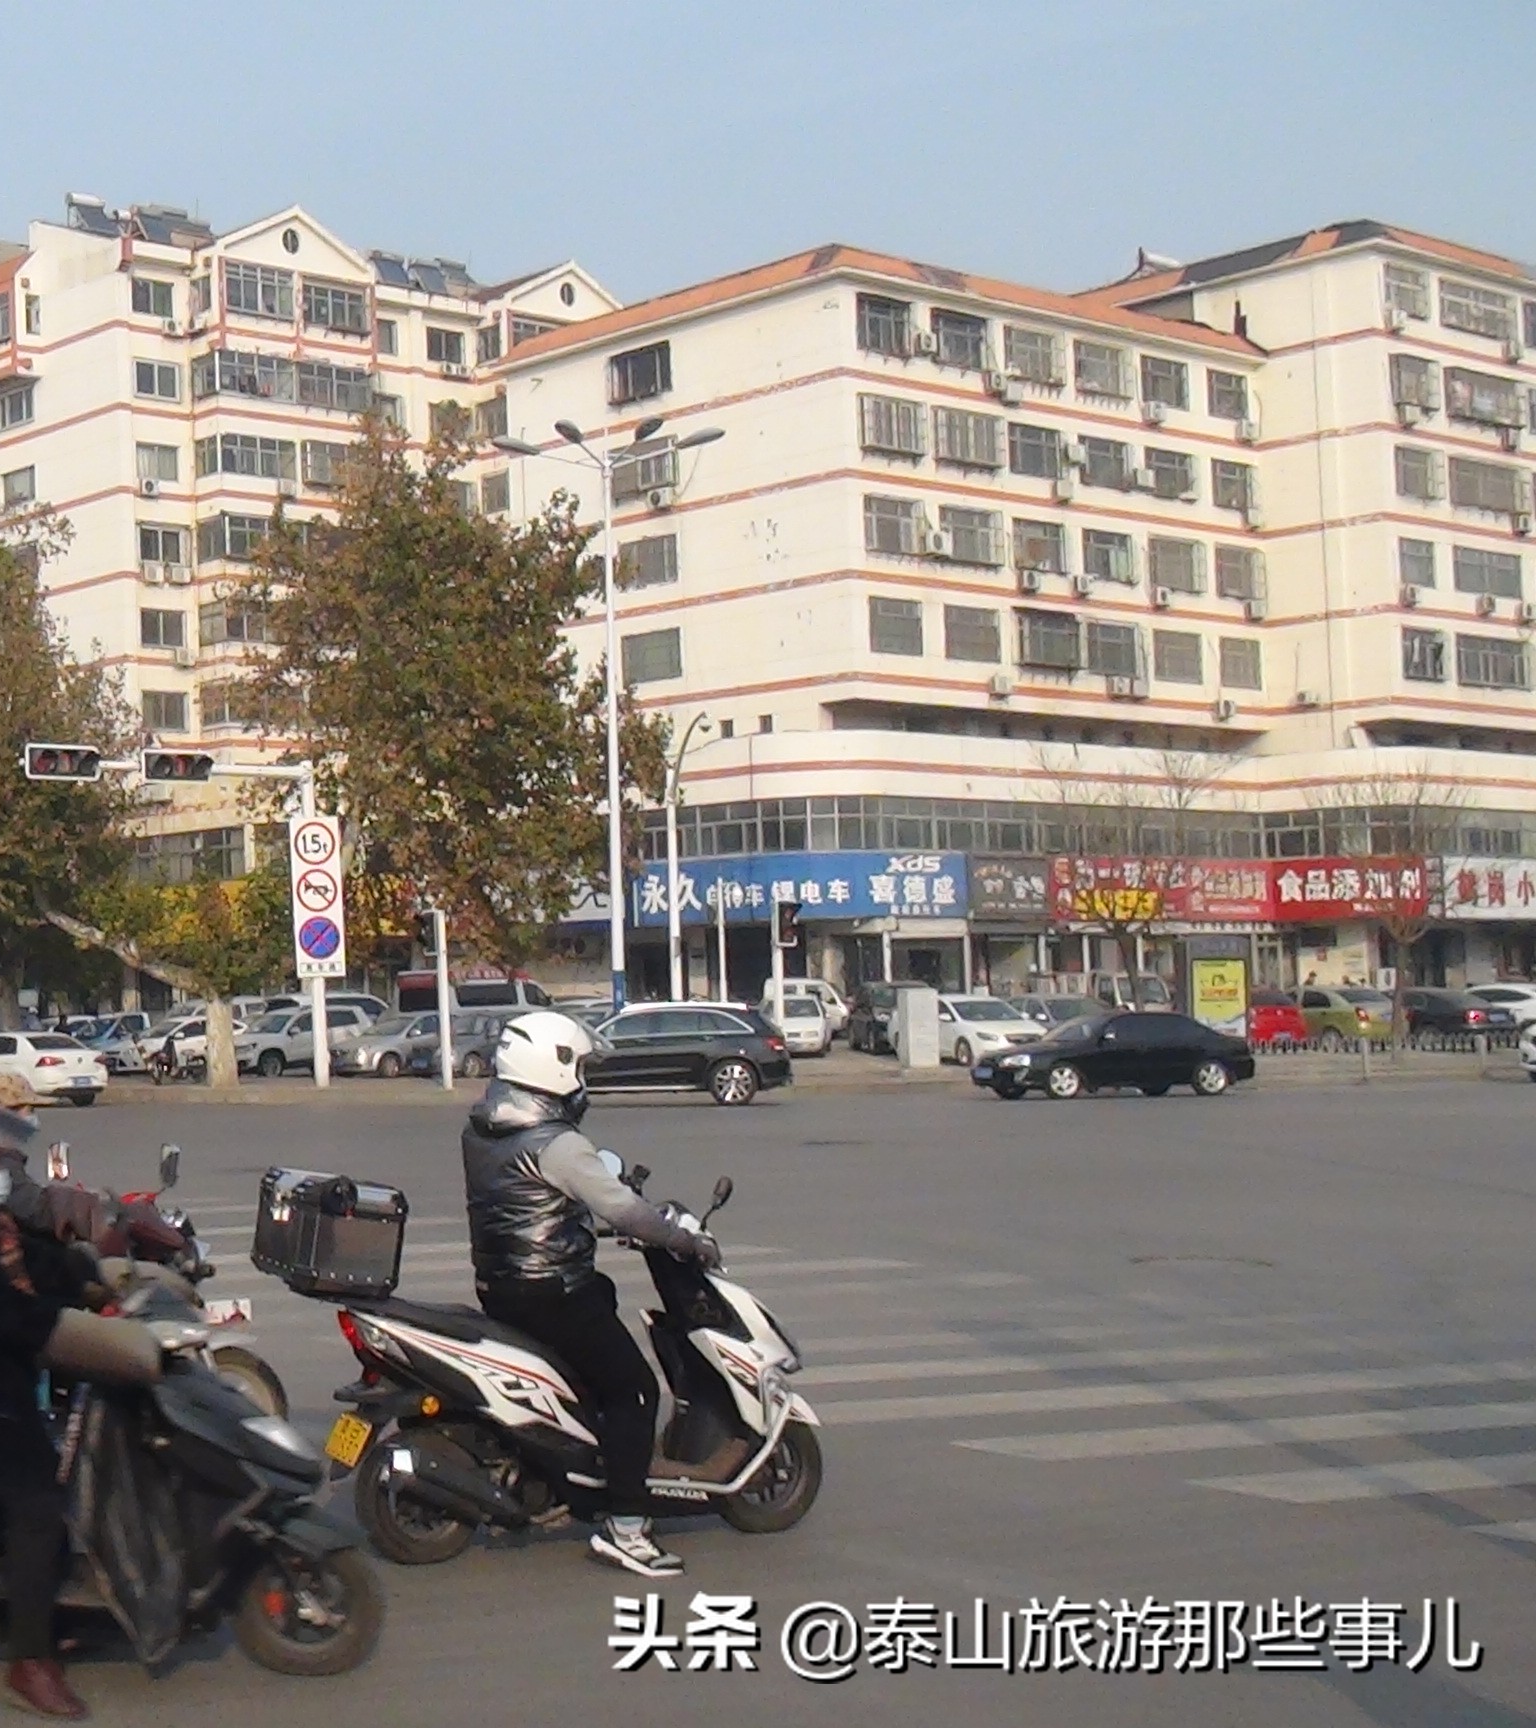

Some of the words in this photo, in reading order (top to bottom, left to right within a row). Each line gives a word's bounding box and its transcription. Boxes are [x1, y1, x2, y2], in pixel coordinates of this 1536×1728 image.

[1277, 867, 1422, 902] 食品添加剂
